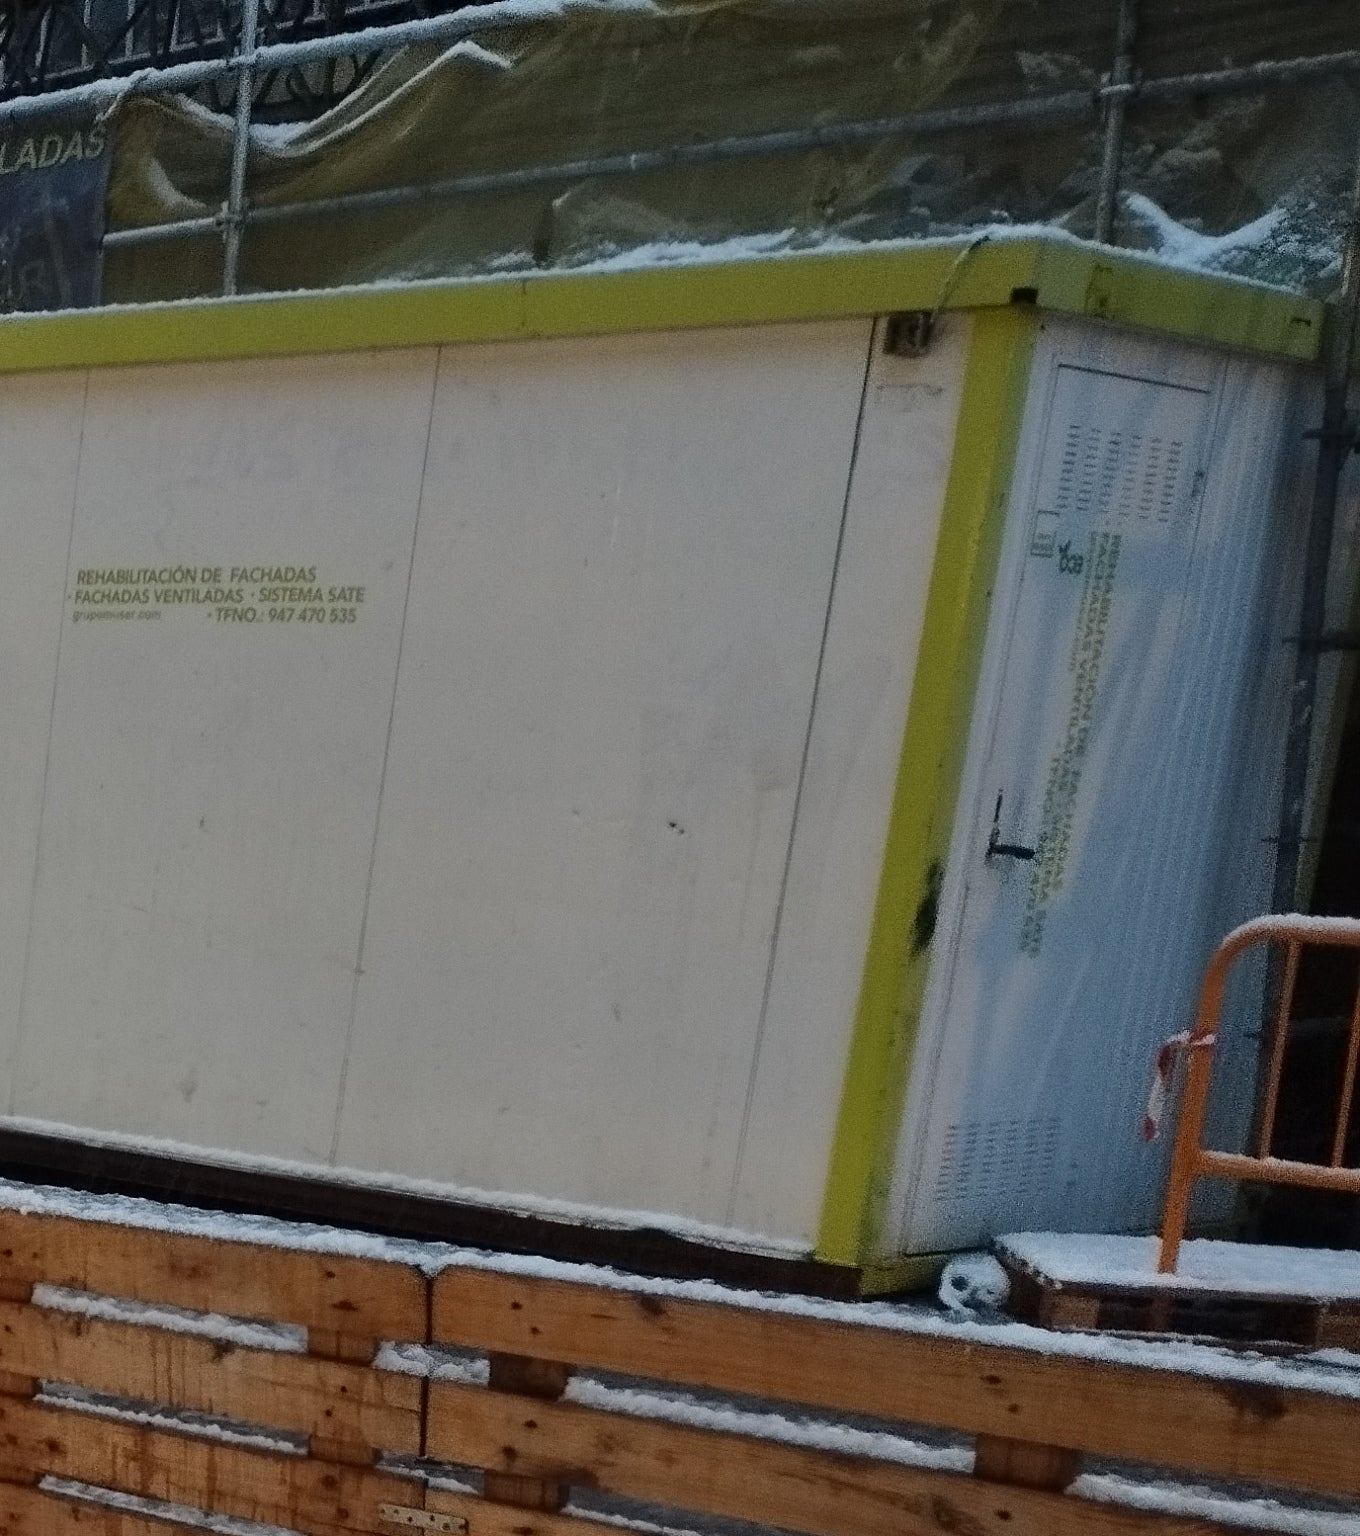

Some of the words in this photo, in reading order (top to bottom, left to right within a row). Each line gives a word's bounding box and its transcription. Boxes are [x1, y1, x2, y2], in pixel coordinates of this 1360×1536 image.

[76, 564, 197, 585] REHABILITACIÓN
[201, 568, 221, 583] DE
[230, 566, 317, 583] FACHADAS
[75, 588, 149, 604] FACHADAS
[154, 588, 244, 604] VENTILADAS
[258, 587, 323, 603] SISTEMA
[328, 587, 366, 603] SATE
[268, 608, 294, 623] 947
[296, 608, 325, 623] 470
[329, 608, 357, 623] 535
